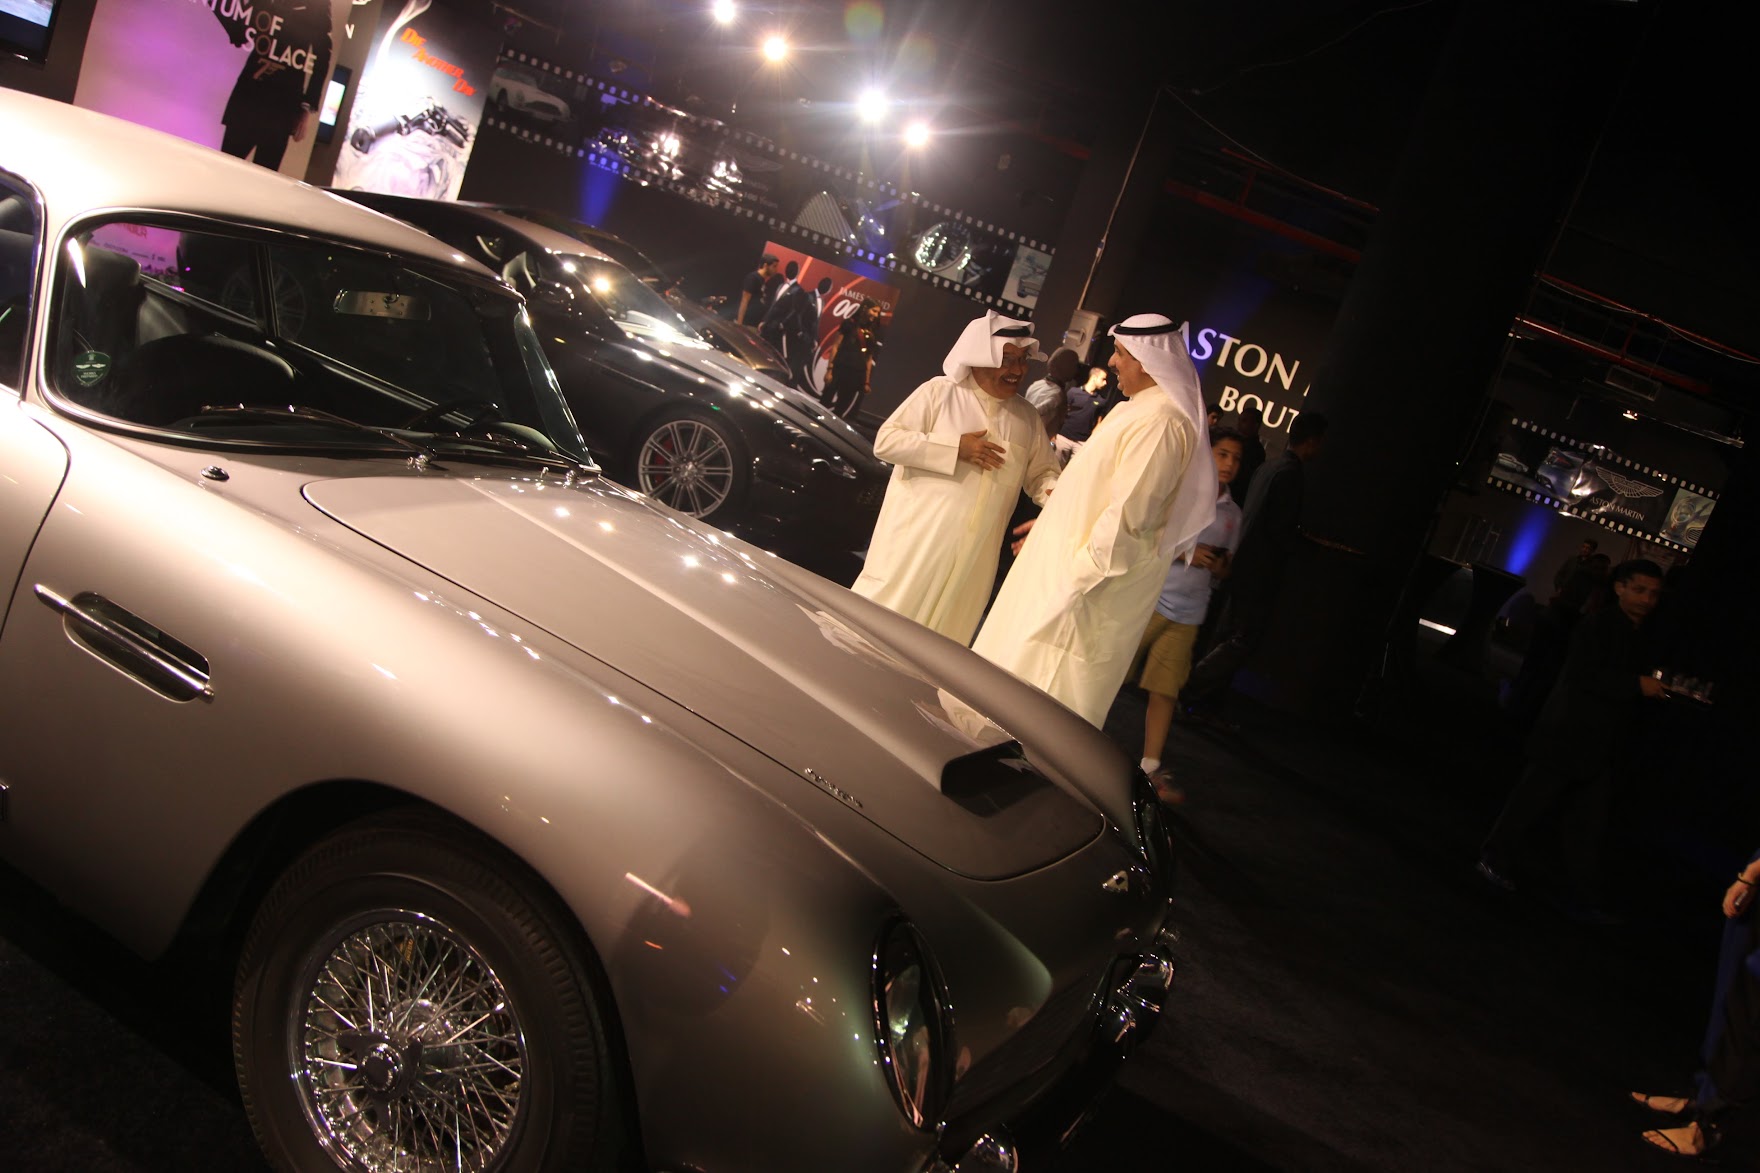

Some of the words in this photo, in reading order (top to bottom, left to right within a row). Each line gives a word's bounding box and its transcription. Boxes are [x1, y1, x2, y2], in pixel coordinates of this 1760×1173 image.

[255, 10, 285, 36] OF
[242, 27, 318, 75] SOLACE
[840, 286, 865, 302] JAMES
[832, 299, 861, 320] 00
[1218, 385, 1300, 434] BOUT
[1591, 496, 1615, 511] ASTON
[1615, 505, 1645, 521] MARTIN
